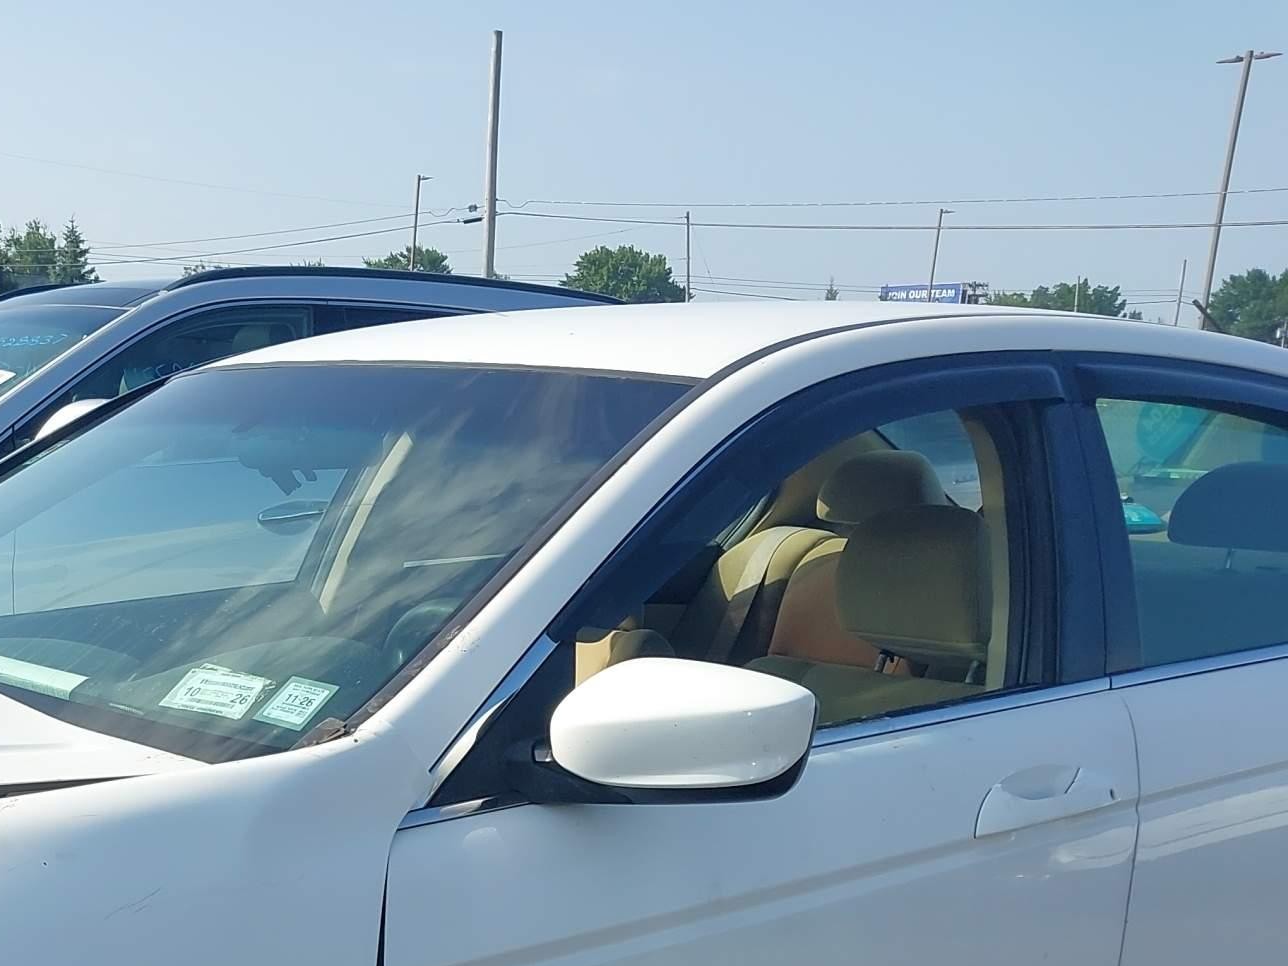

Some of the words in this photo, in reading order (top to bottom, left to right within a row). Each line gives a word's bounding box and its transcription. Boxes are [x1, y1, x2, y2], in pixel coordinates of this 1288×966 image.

[887, 291, 907, 300] JOIN
[908, 289, 928, 299] OUR
[931, 288, 956, 298] TEAM
[184, 685, 202, 697] 10
[229, 693, 251, 705] 26
